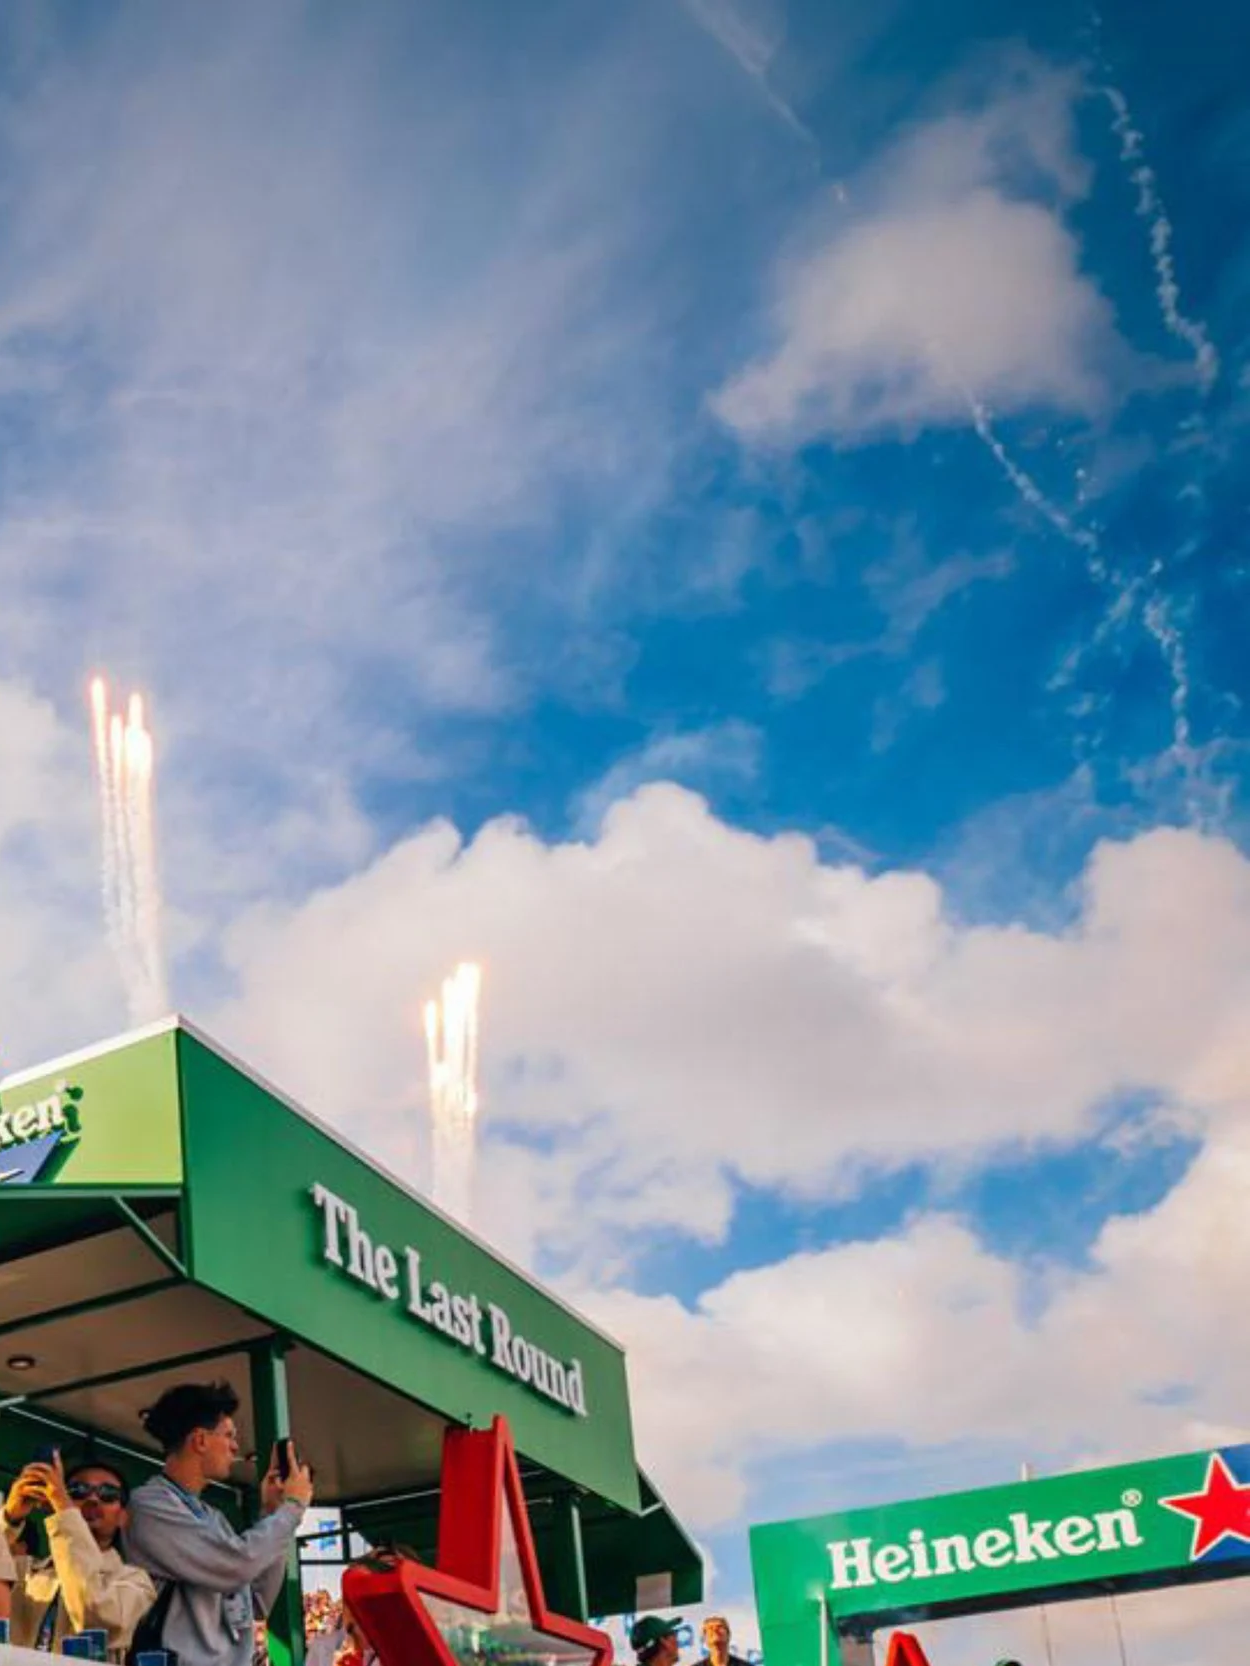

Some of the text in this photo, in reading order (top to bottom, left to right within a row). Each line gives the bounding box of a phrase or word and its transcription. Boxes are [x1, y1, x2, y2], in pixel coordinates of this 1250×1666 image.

[310, 1181, 588, 1417] The Last Round
[826, 1508, 1144, 1590] Heineken
